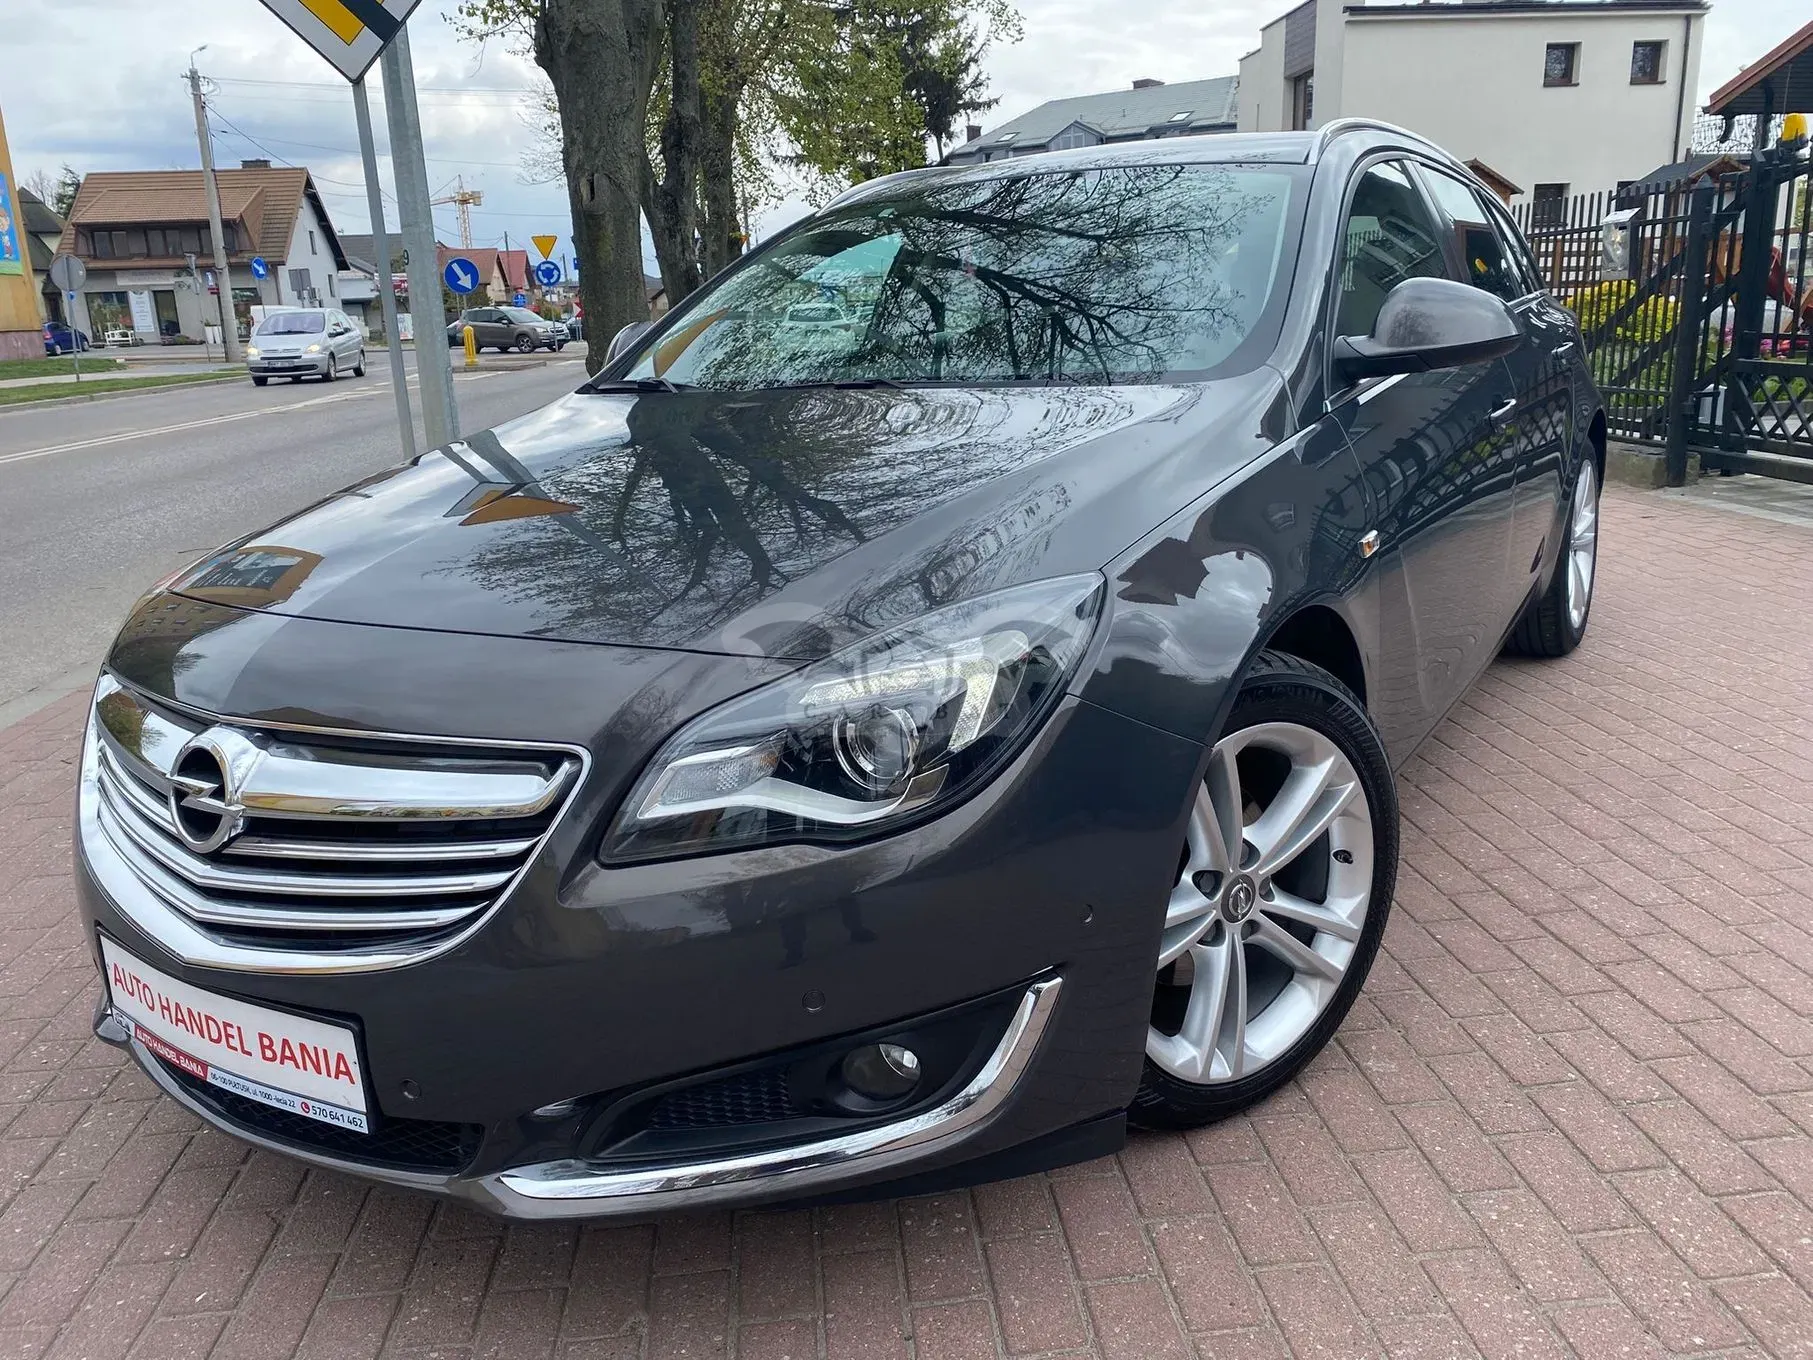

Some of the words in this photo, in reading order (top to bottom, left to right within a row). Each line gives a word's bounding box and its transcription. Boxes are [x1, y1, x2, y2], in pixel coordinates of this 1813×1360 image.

[113, 963, 155, 1012] AUTO
[158, 993, 253, 1057] HANDEL
[258, 1032, 356, 1085] BANIA
[136, 1028, 152, 1048] AUTO
[152, 1040, 180, 1064] HANDEL
[180, 1056, 205, 1077] BANIA
[288, 1100, 296, 1108] 22
[312, 1105, 328, 1118] 570
[329, 1112, 345, 1123] 641
[347, 1116, 364, 1129] 462
